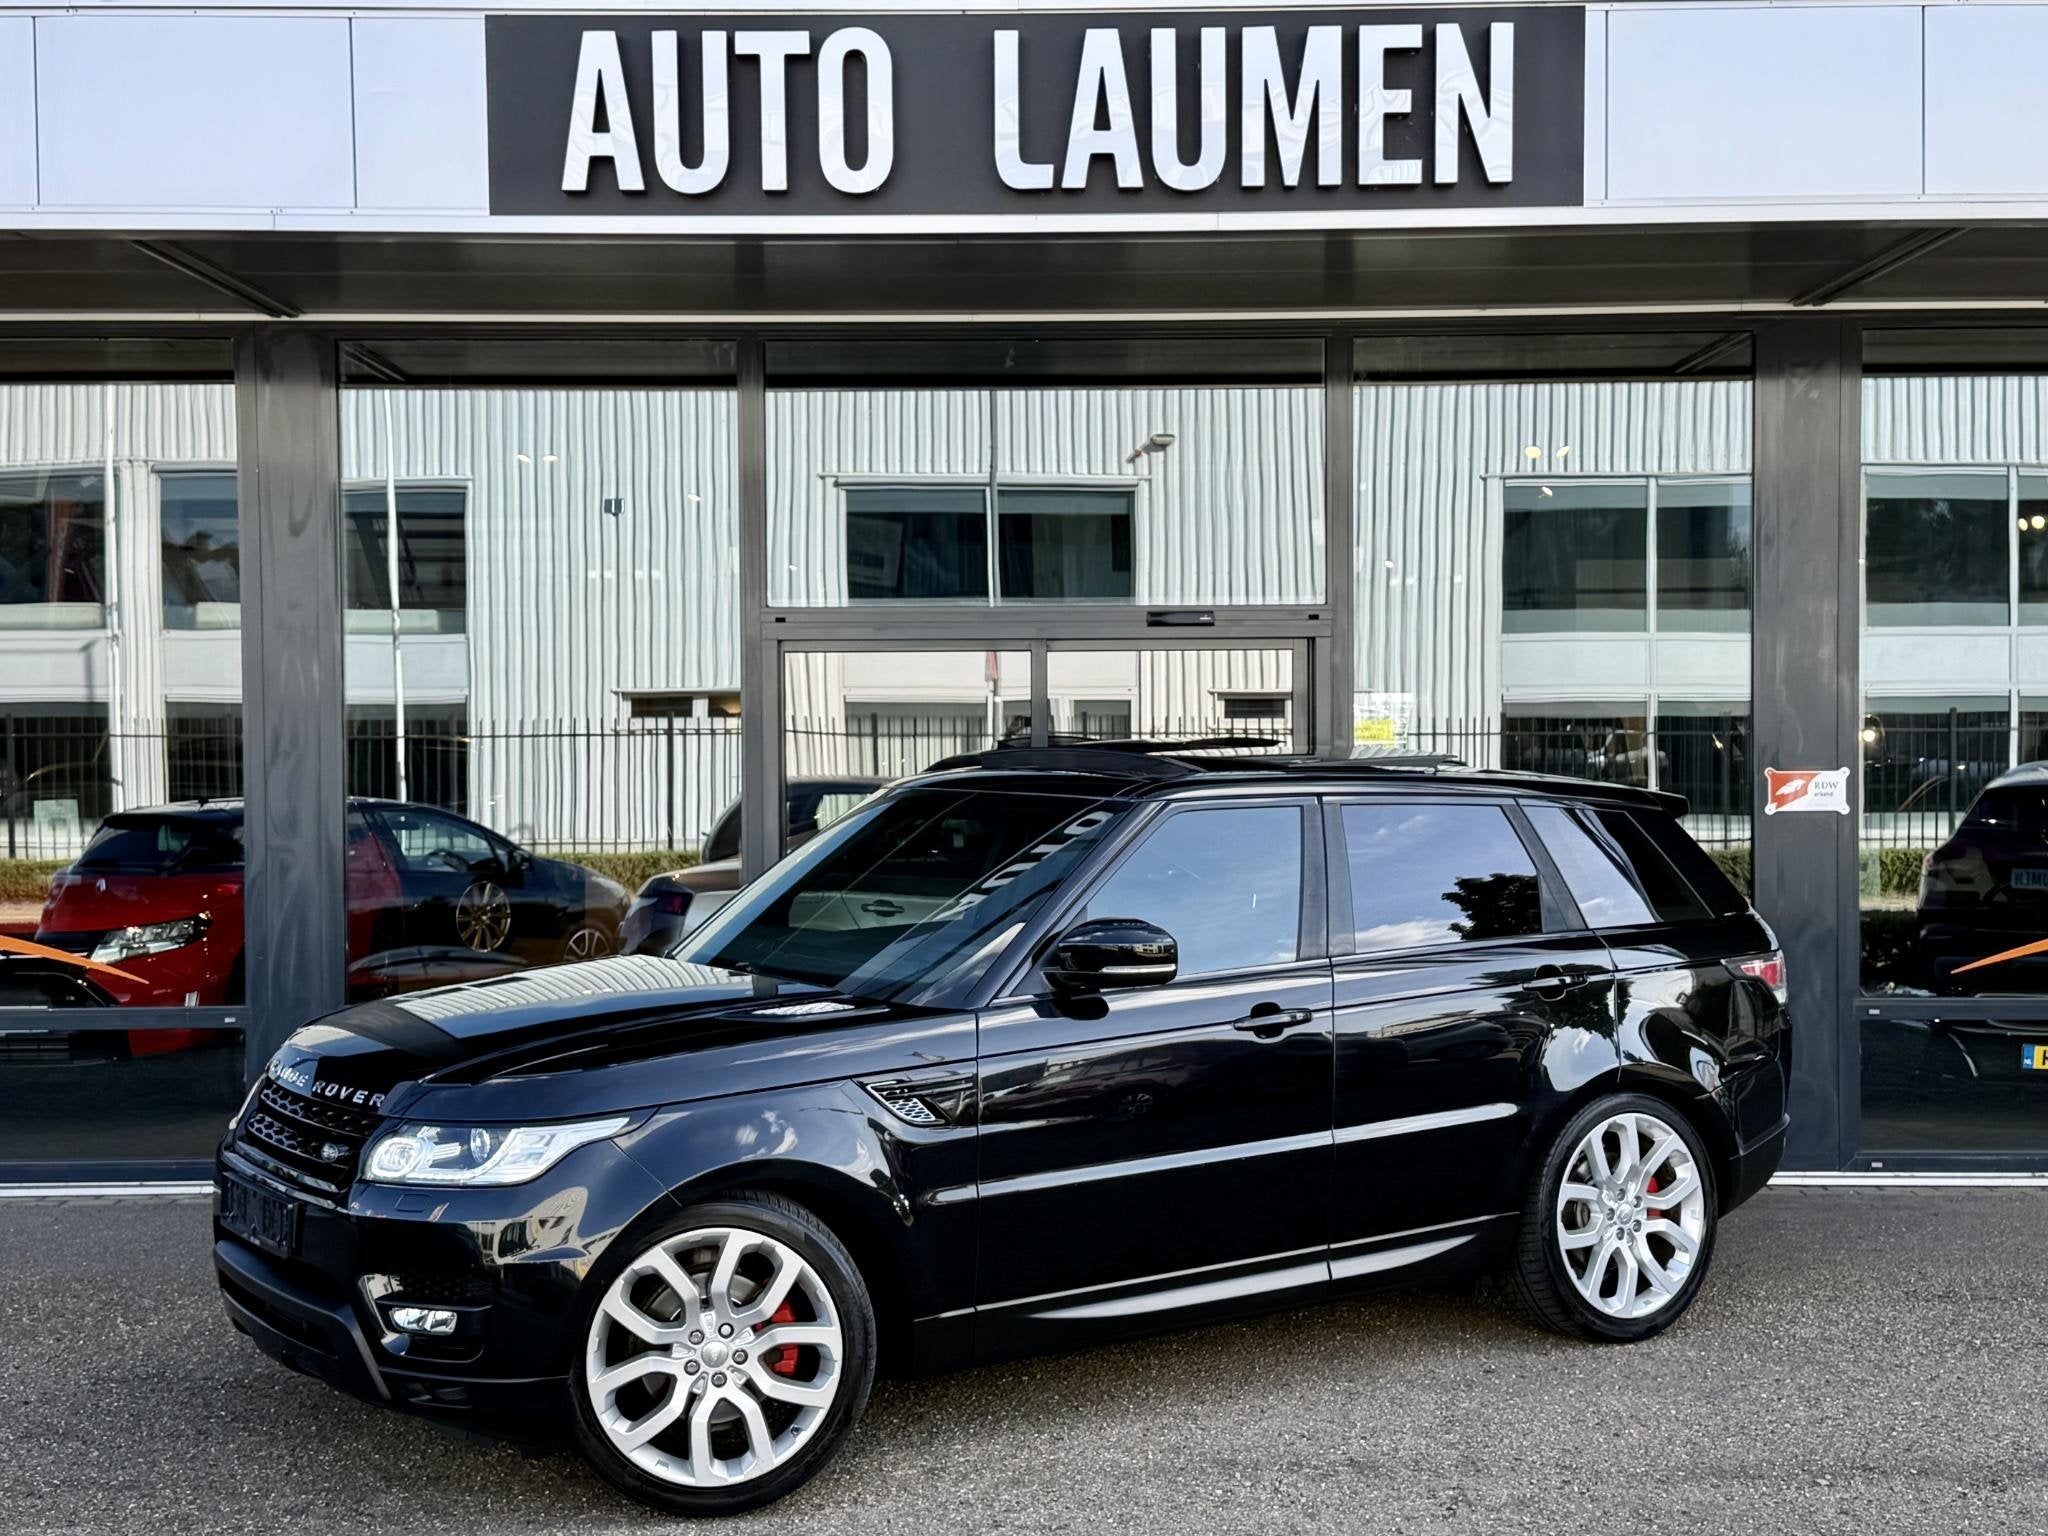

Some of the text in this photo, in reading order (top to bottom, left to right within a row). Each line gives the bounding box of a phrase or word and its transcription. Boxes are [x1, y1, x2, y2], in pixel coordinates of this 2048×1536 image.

[561, 22, 1515, 195] AUTO LAUMEN
[1814, 781, 1839, 790] RDW
[269, 1059, 386, 1108] RANGE ROVER
